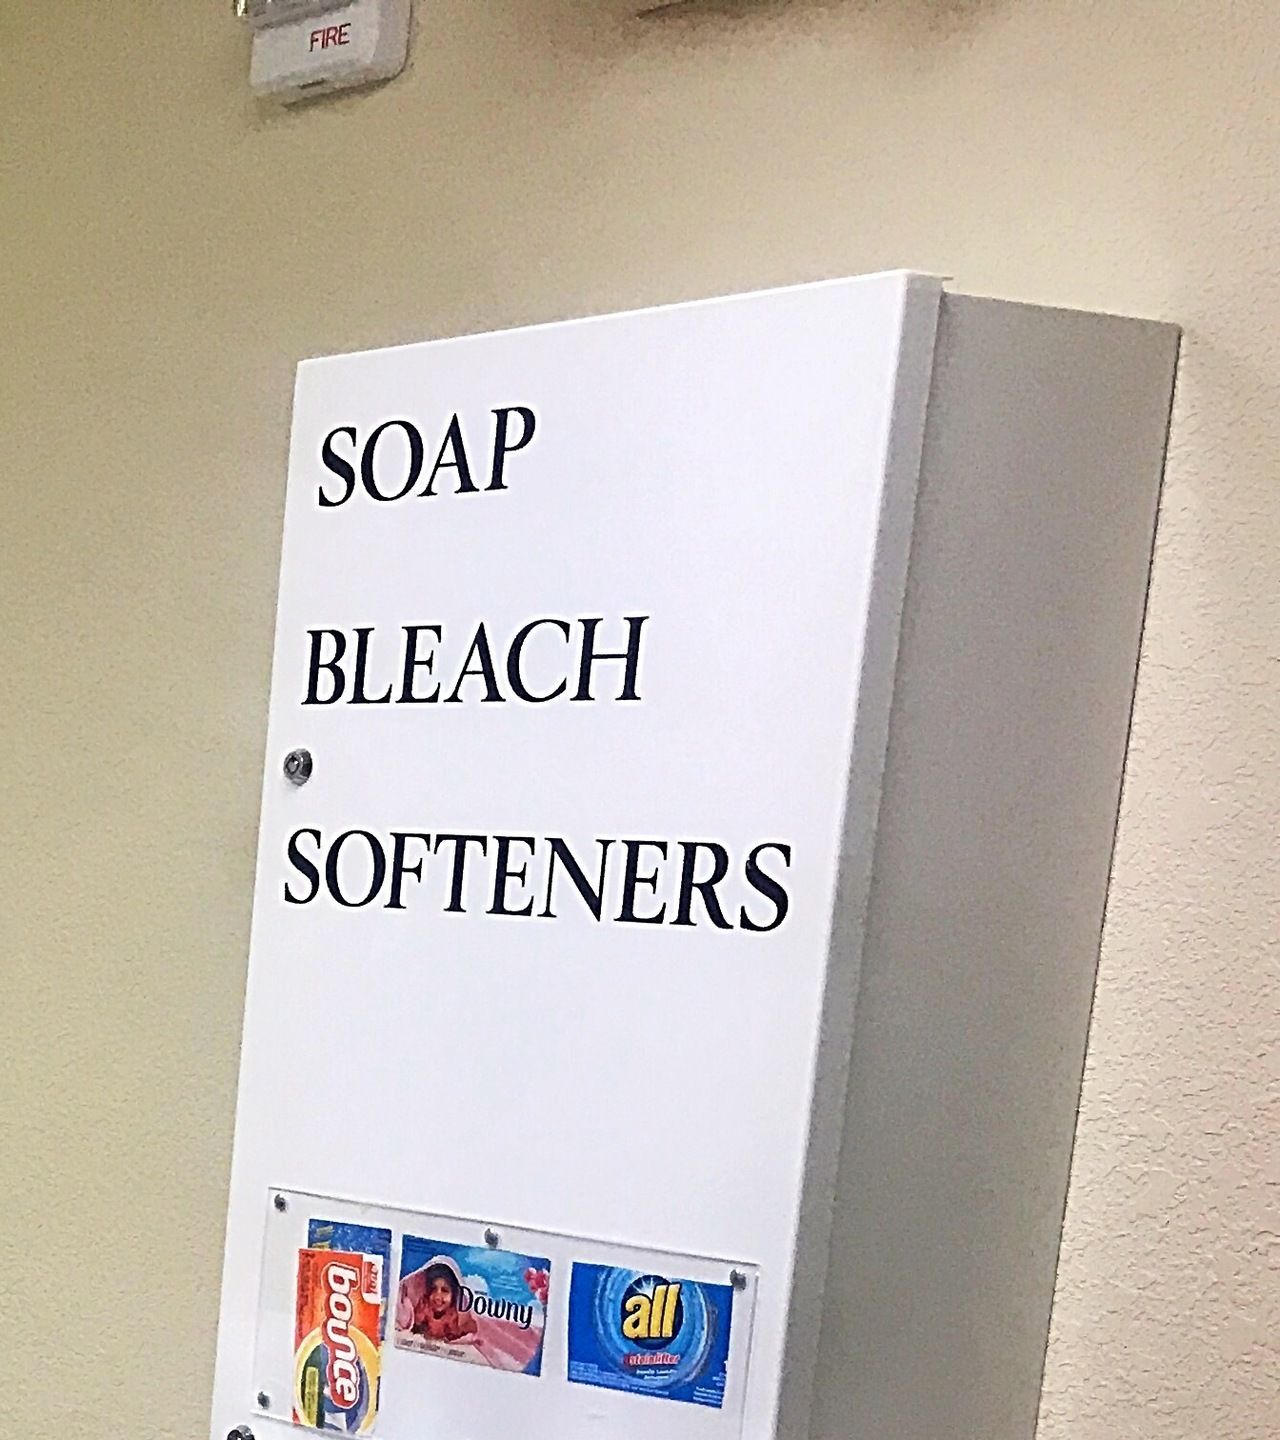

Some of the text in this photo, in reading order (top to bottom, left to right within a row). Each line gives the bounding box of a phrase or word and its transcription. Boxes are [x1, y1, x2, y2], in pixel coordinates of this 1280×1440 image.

[309, 23, 351, 52] FIRE
[317, 405, 537, 508] SOAP
[300, 615, 650, 706] BLEACH
[283, 827, 793, 933] SOFTENERS
[326, 1262, 359, 1405] bounce
[458, 1285, 533, 1330] Downy
[622, 1283, 681, 1339] all
